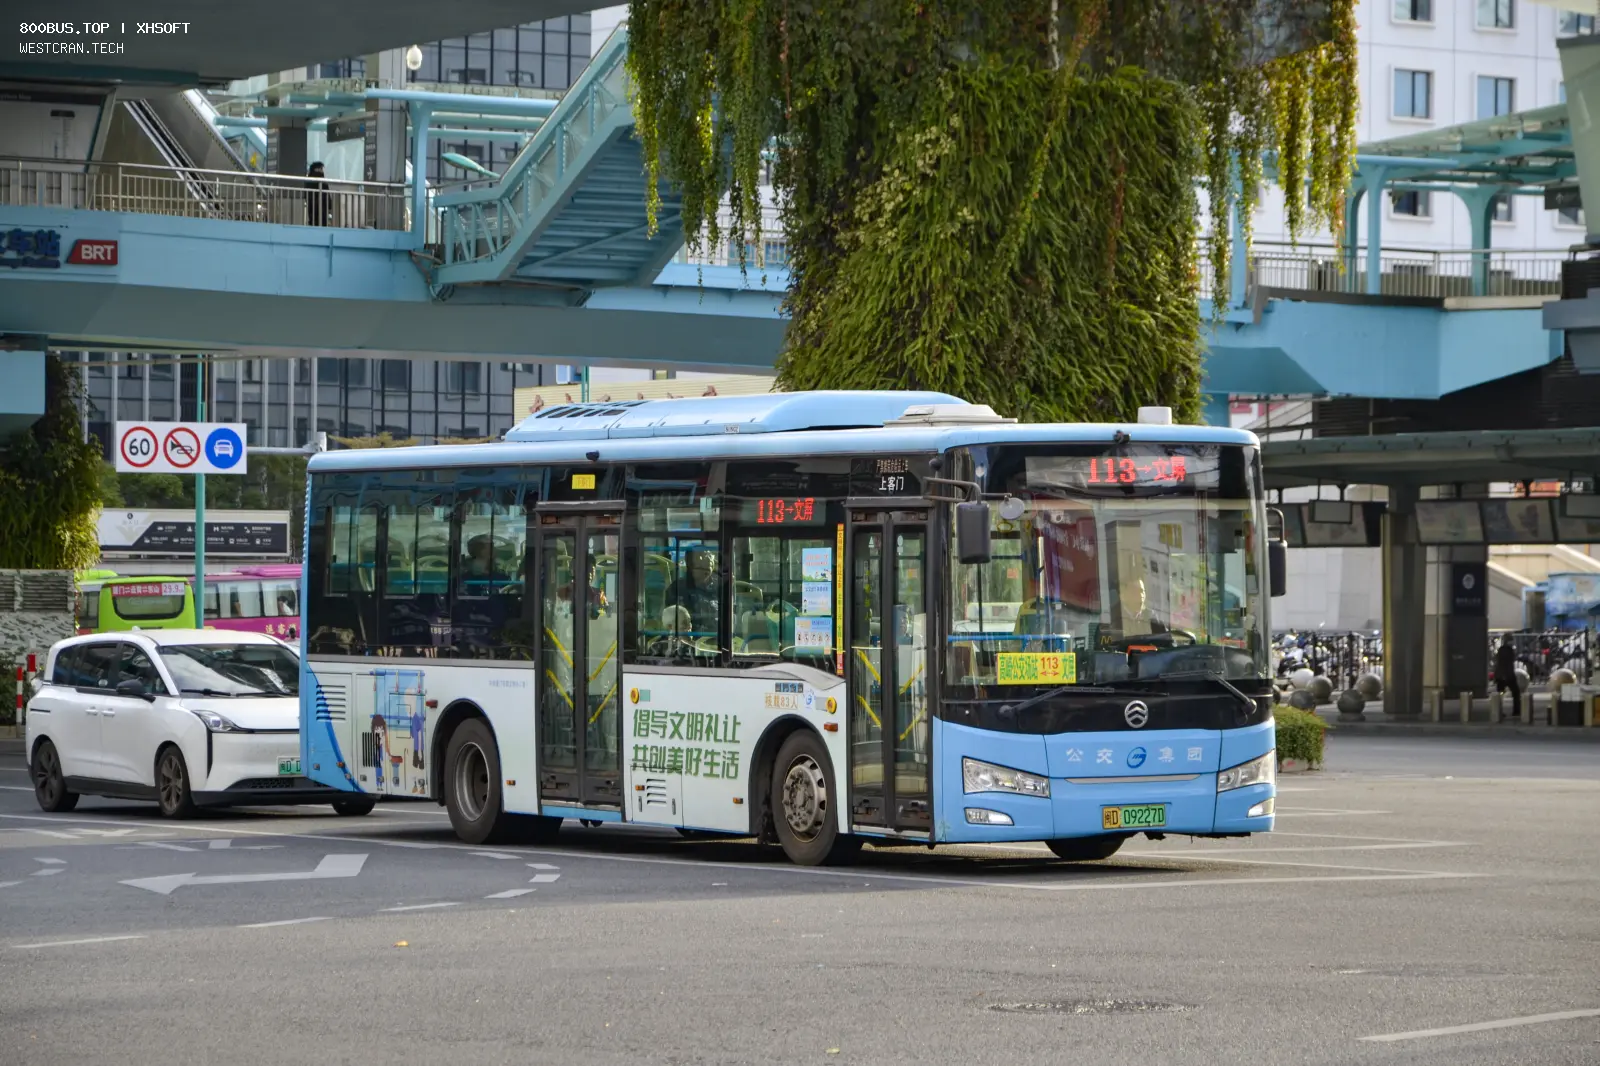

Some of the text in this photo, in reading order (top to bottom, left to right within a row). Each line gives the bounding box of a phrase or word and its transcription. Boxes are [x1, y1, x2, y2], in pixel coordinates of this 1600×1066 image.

[81, 244, 115, 260] BRT
[129, 437, 150, 456] 60
[1087, 457, 1136, 483] 113
[879, 476, 904, 492] 上客门
[757, 499, 785, 524] 113
[1040, 656, 1059, 670] 113
[633, 708, 741, 744] 倡导文明礼让
[632, 744, 740, 780] 共创美好生活
[1066, 747, 1203, 764] 公交 集团
[1123, 807, 1165, 825] 09227D
